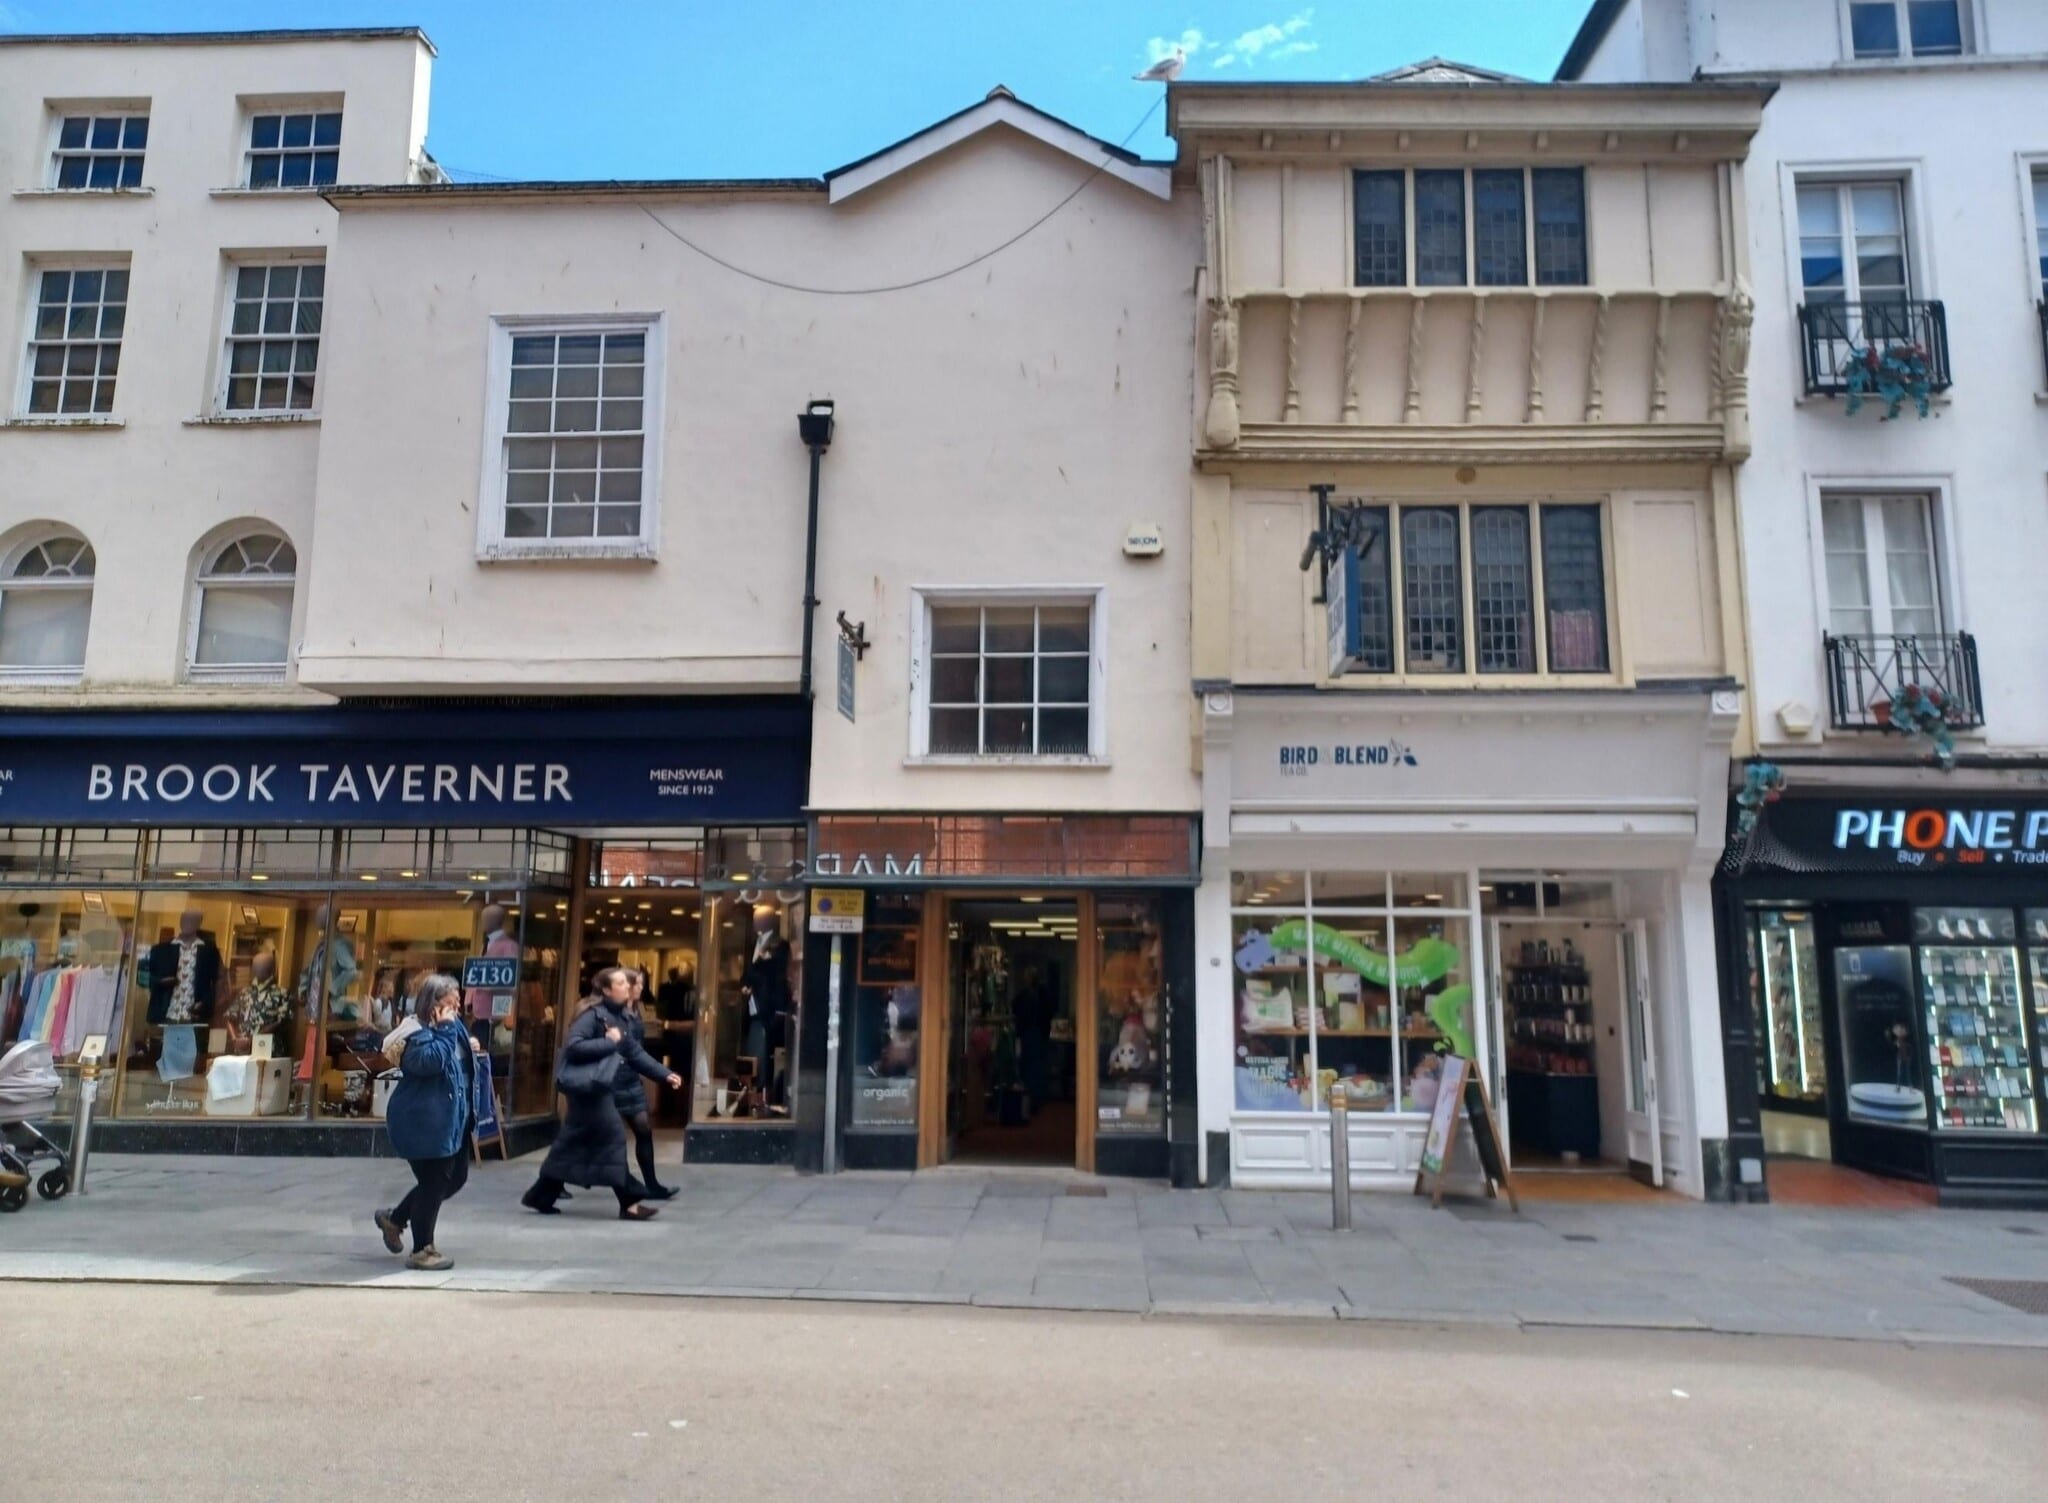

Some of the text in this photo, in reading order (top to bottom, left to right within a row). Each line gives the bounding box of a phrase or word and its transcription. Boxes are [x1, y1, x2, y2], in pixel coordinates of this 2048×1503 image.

[1280, 746, 1319, 765] BIRD
[1334, 746, 1389, 765] BLEND
[88, 764, 573, 801] BROOK TAVERNER
[649, 769, 724, 780] MENSWEAR
[658, 785, 714, 795] SINCE 1912
[1833, 809, 2015, 849] PHONE
[1896, 850, 1925, 866] Buy
[1958, 850, 1984, 863] Sell
[466, 967, 513, 985] £130
[863, 1088, 909, 1101] organic
